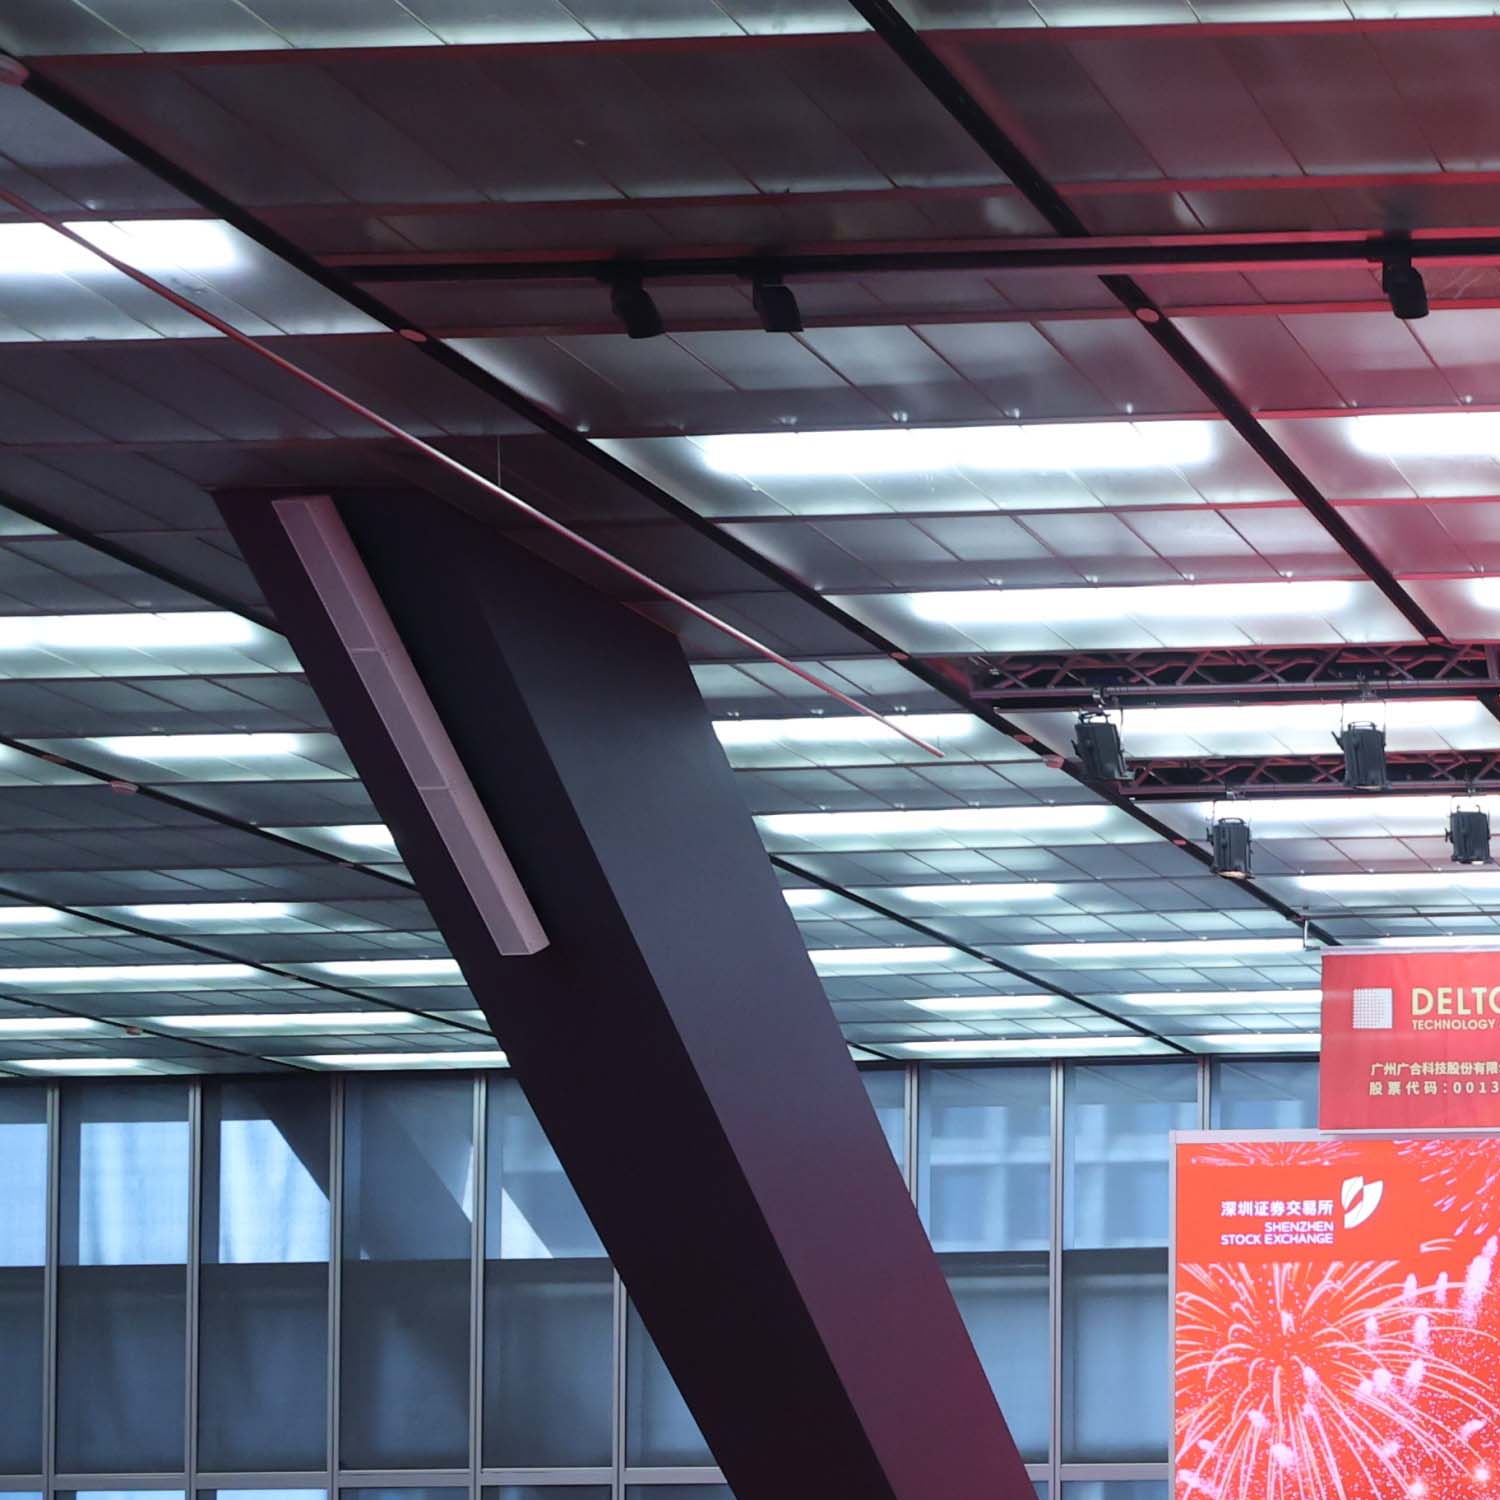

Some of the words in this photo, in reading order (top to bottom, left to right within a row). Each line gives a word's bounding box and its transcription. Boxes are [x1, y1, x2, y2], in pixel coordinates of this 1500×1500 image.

[1412, 1019, 1496, 1031] TECHNOLOGY
[1221, 1200, 1334, 1217] 深圳证券交易所
[1264, 1221, 1334, 1232] SHENZHEN
[1221, 1234, 1262, 1246] STOCK
[1264, 1233, 1334, 1245] EXCHANGE
